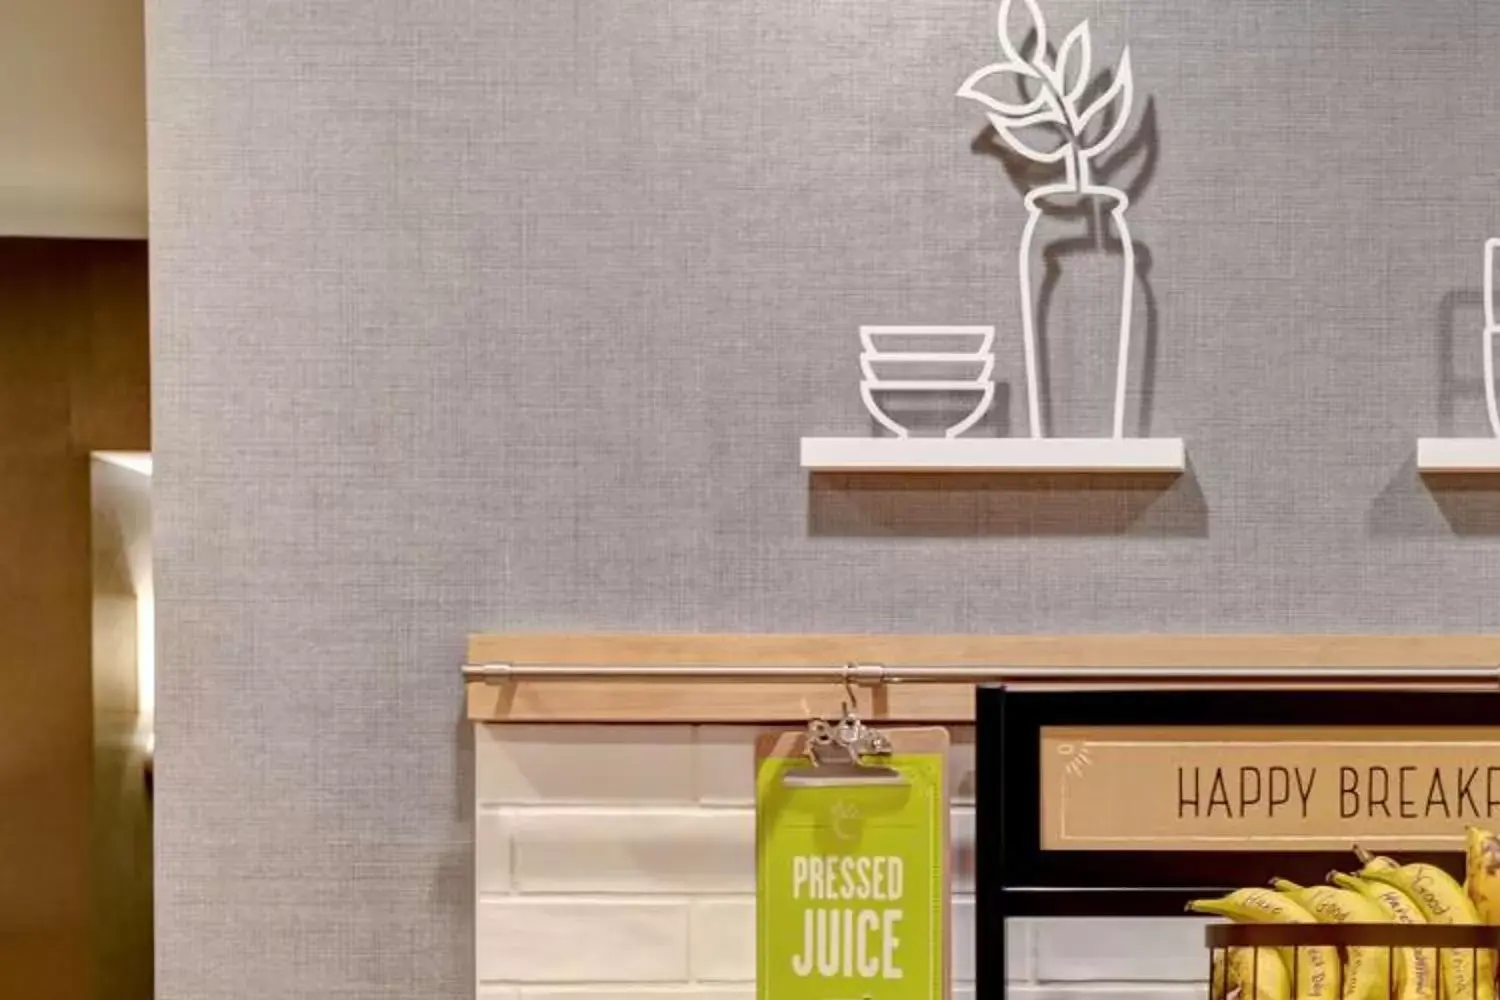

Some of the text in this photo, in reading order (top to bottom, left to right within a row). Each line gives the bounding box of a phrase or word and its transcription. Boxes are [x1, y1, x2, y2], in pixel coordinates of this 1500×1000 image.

[1178, 766, 1317, 818] HAPPY
[793, 856, 904, 900] PRESSED
[792, 909, 903, 979] JUICE
